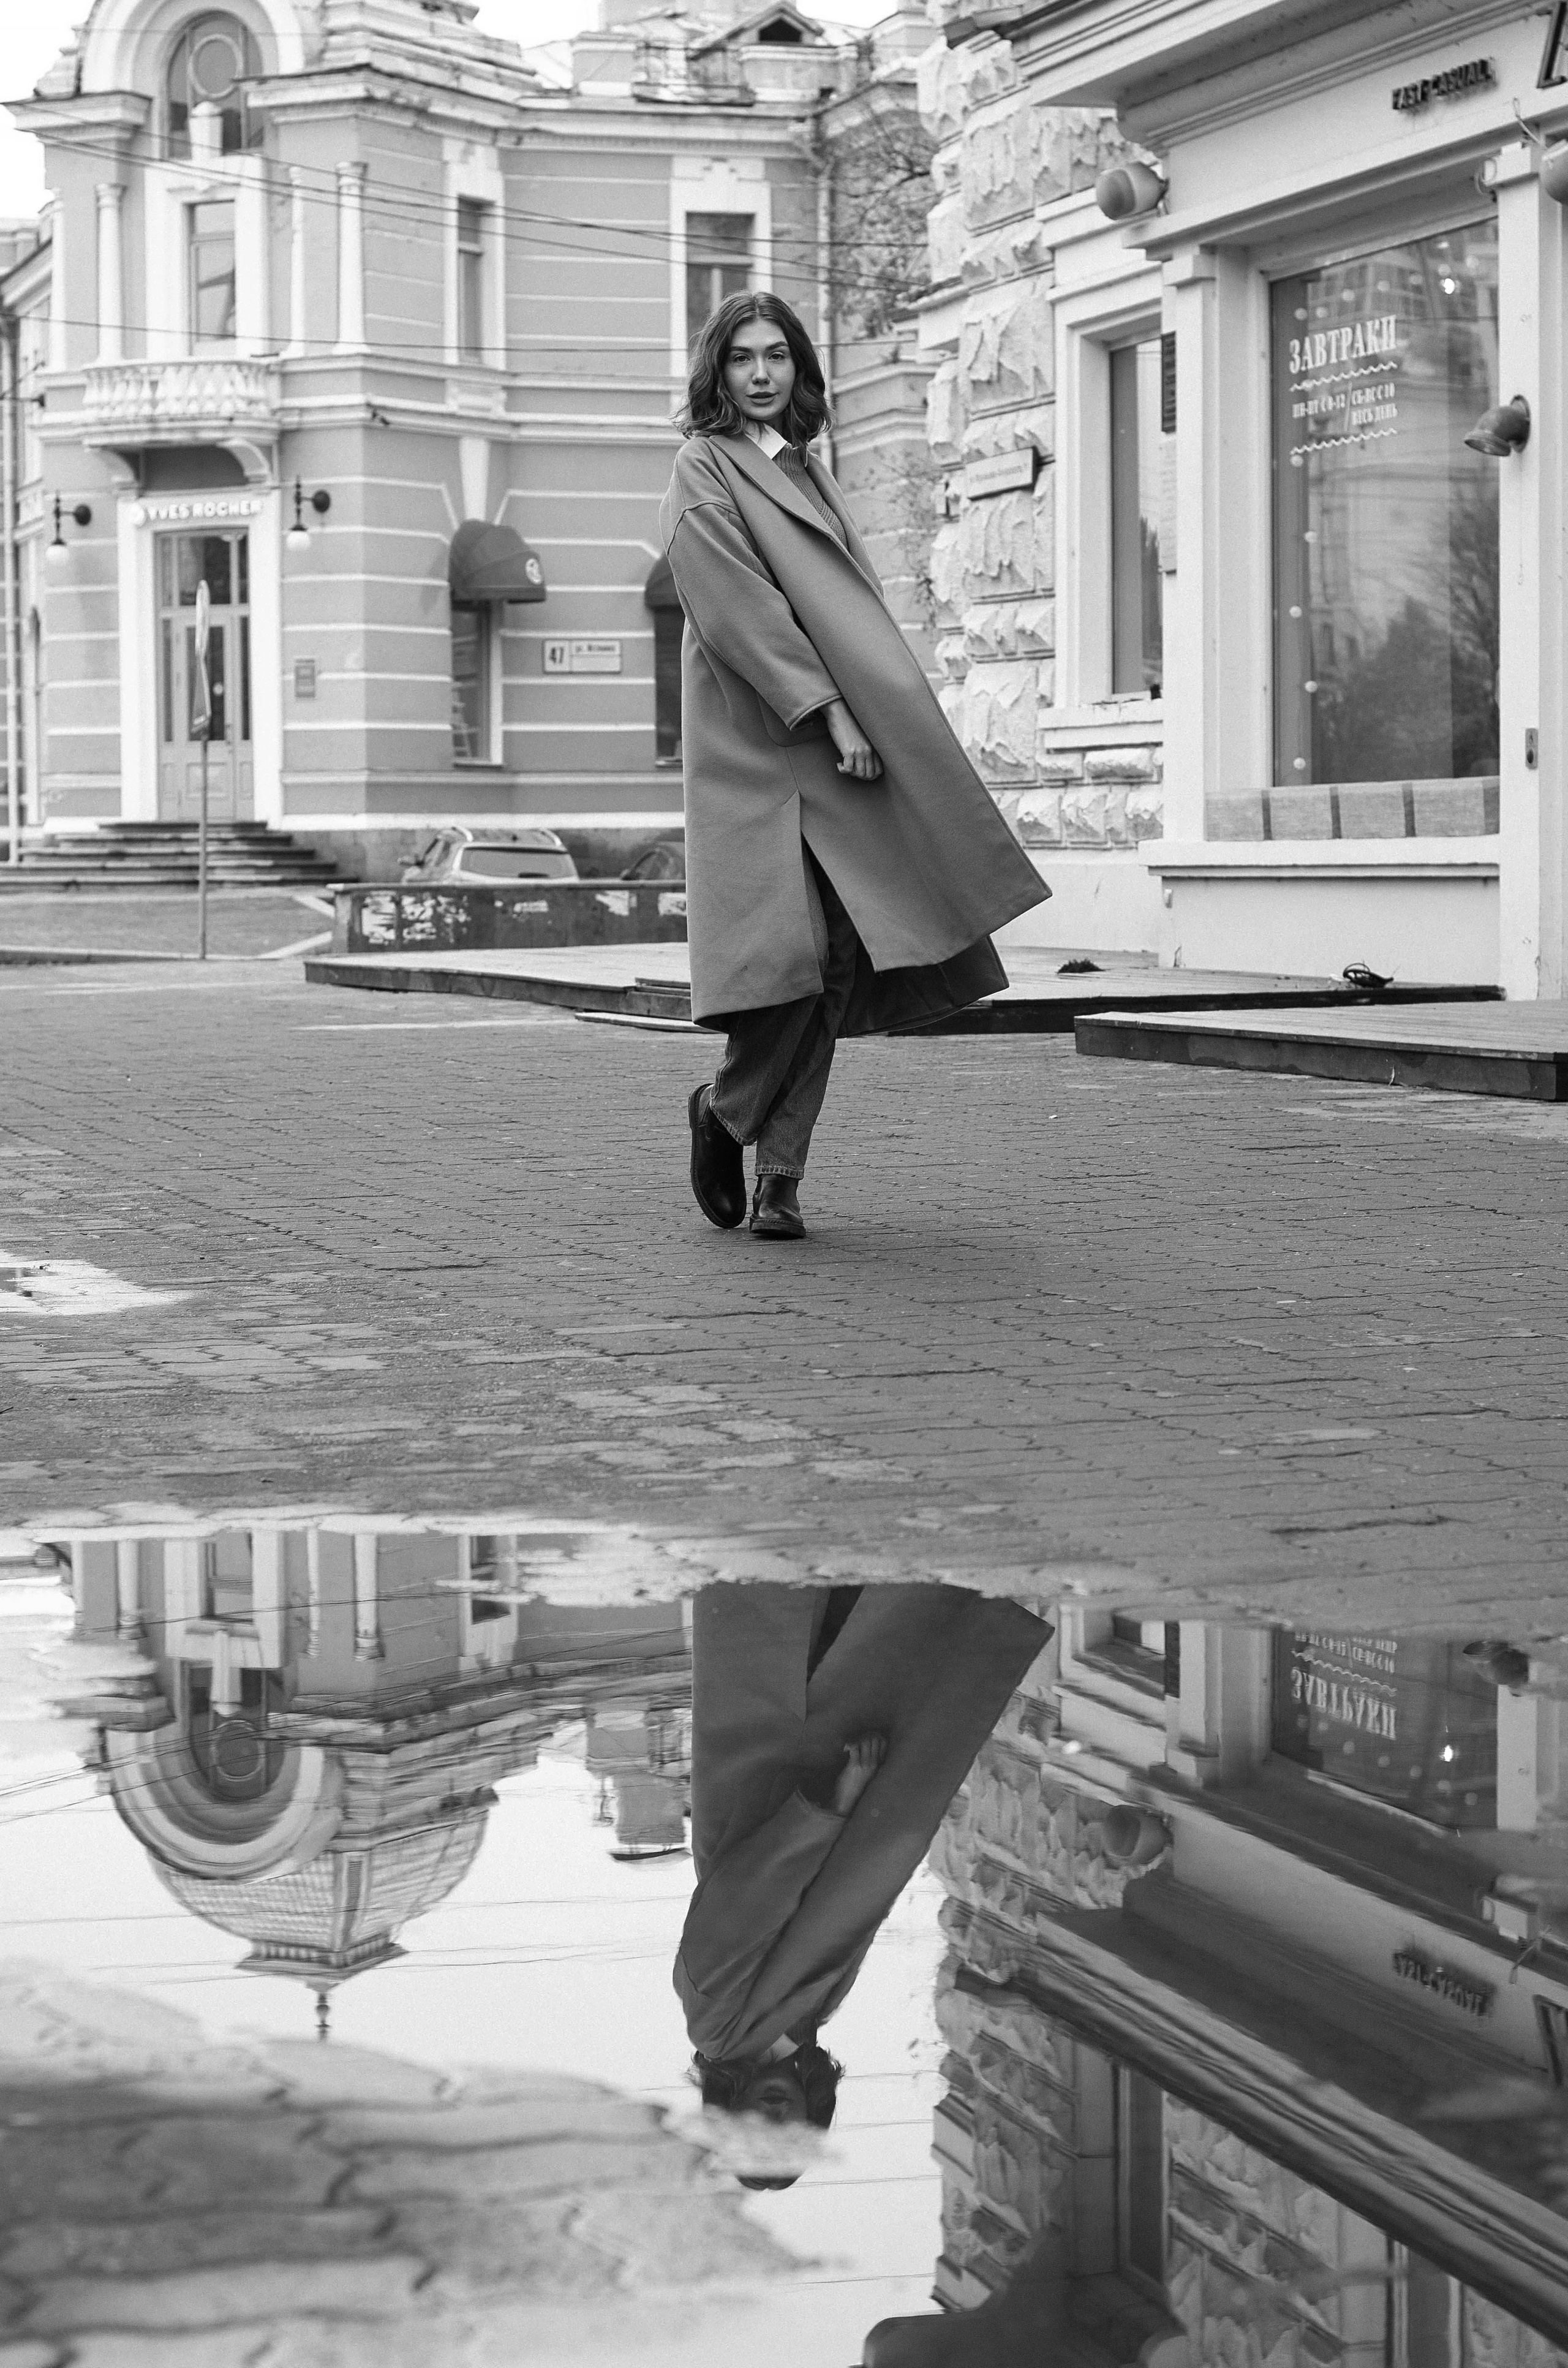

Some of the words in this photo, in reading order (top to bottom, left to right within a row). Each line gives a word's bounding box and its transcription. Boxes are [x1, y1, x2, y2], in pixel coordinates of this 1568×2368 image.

[1289, 315, 1396, 374] ЗАВТРАКИ
[146, 503, 190, 521] YVES
[192, 499, 263, 518] ROCHER
